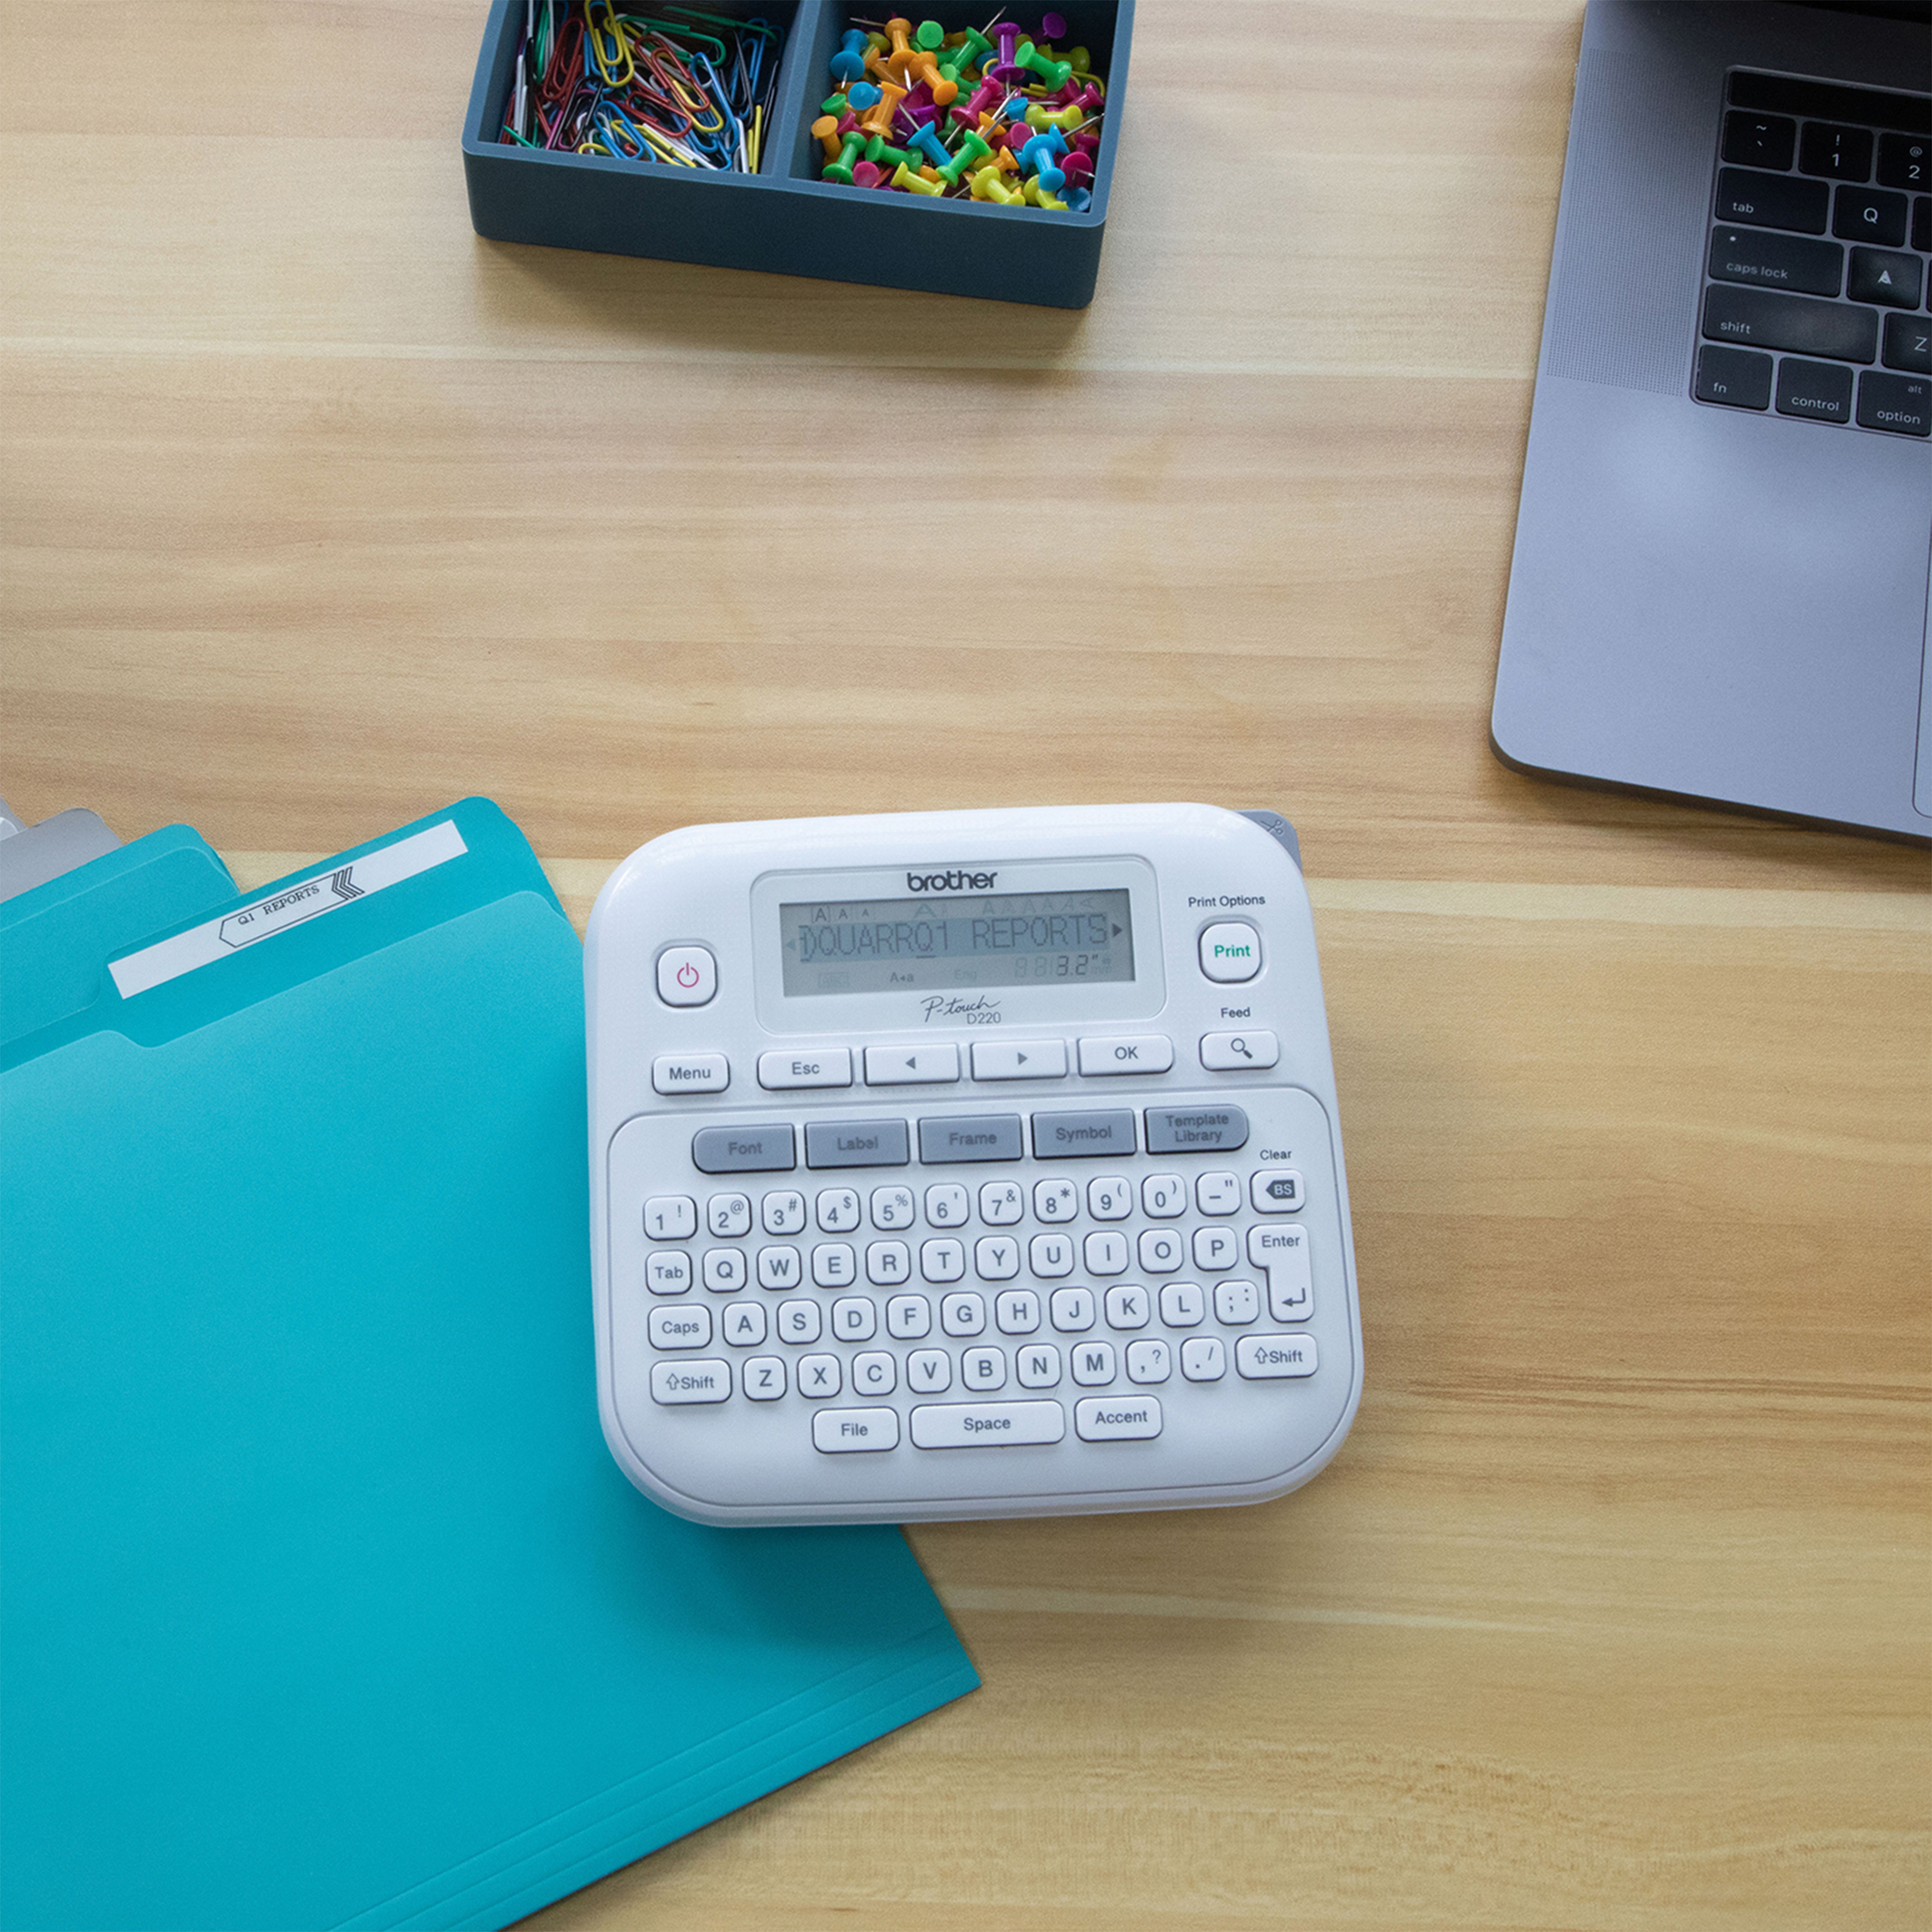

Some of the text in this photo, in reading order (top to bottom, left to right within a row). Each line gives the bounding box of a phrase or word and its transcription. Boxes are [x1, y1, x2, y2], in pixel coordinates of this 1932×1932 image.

[1832, 153, 1840, 167] 1
[1908, 164, 1921, 179] 2
[1733, 202, 1755, 213] tab
[1864, 207, 1878, 224] Q
[1726, 263, 1788, 279] caps lock
[1720, 321, 1751, 335] shift
[1914, 335, 1928, 352] Z
[1713, 382, 1727, 393] fn
[1907, 385, 1922, 394] alt
[1791, 396, 1840, 411] control
[1877, 410, 1921, 425] option
[907, 870, 998, 891] brother
[238, 885, 320, 925] Q1 REPORTS
[1187, 895, 1266, 909] Print Options
[972, 914, 1108, 949] REPORTS
[1214, 944, 1251, 958] Print
[967, 1012, 1002, 1024] D220
[1220, 1006, 1251, 1019] Feed
[1114, 1046, 1139, 1061] OK
[668, 1066, 711, 1080] Menu
[791, 1061, 820, 1076] Esc
[1165, 1113, 1229, 1128] Template
[948, 1132, 998, 1146] Frame
[1056, 1125, 1113, 1143] Symbol
[1174, 1129, 1222, 1143] Library
[727, 1141, 763, 1156] Font
[837, 1135, 879, 1151] Label
[1259, 1149, 1292, 1161] Clear
[1273, 1184, 1293, 1196] BS
[936, 1201, 948, 1220] 6
[991, 1199, 1003, 1216] 7
[1045, 1197, 1057, 1215] 8
[1099, 1193, 1113, 1211] 9
[717, 1211, 730, 1229] 2
[773, 1208, 785, 1227] 3
[826, 1207, 839, 1224] 4
[883, 1204, 895, 1222] 5
[655, 1214, 664, 1231] 1
[1210, 1239, 1225, 1258] P
[1261, 1234, 1301, 1249] Enter
[991, 1249, 1006, 1267] Y
[1046, 1246, 1062, 1265] U
[1154, 1241, 1171, 1260] O
[768, 1258, 790, 1277] W
[827, 1256, 842, 1274] E
[882, 1254, 898, 1272] R
[937, 1251, 951, 1270] T
[654, 1265, 684, 1280] Tab
[716, 1260, 733, 1280] Q
[1012, 1302, 1027, 1321] H
[1068, 1300, 1080, 1319] J
[1121, 1297, 1137, 1316] K
[1178, 1294, 1191, 1313] L
[792, 1312, 807, 1331] S
[847, 1310, 863, 1329] D
[904, 1307, 917, 1326] F
[956, 1304, 973, 1323] G
[661, 1320, 700, 1337] Caps
[737, 1315, 753, 1333] A
[1085, 1352, 1104, 1372] M
[1269, 1350, 1303, 1364] Shift
[867, 1364, 883, 1383] C
[922, 1361, 937, 1380] V
[978, 1359, 993, 1378] B
[1032, 1357, 1048, 1375] N
[681, 1376, 715, 1390] Shift
[759, 1369, 773, 1388] Z
[813, 1366, 827, 1385] X
[1094, 1409, 1148, 1424] Accent
[840, 1423, 869, 1437] File
[963, 1417, 1011, 1434] Space
